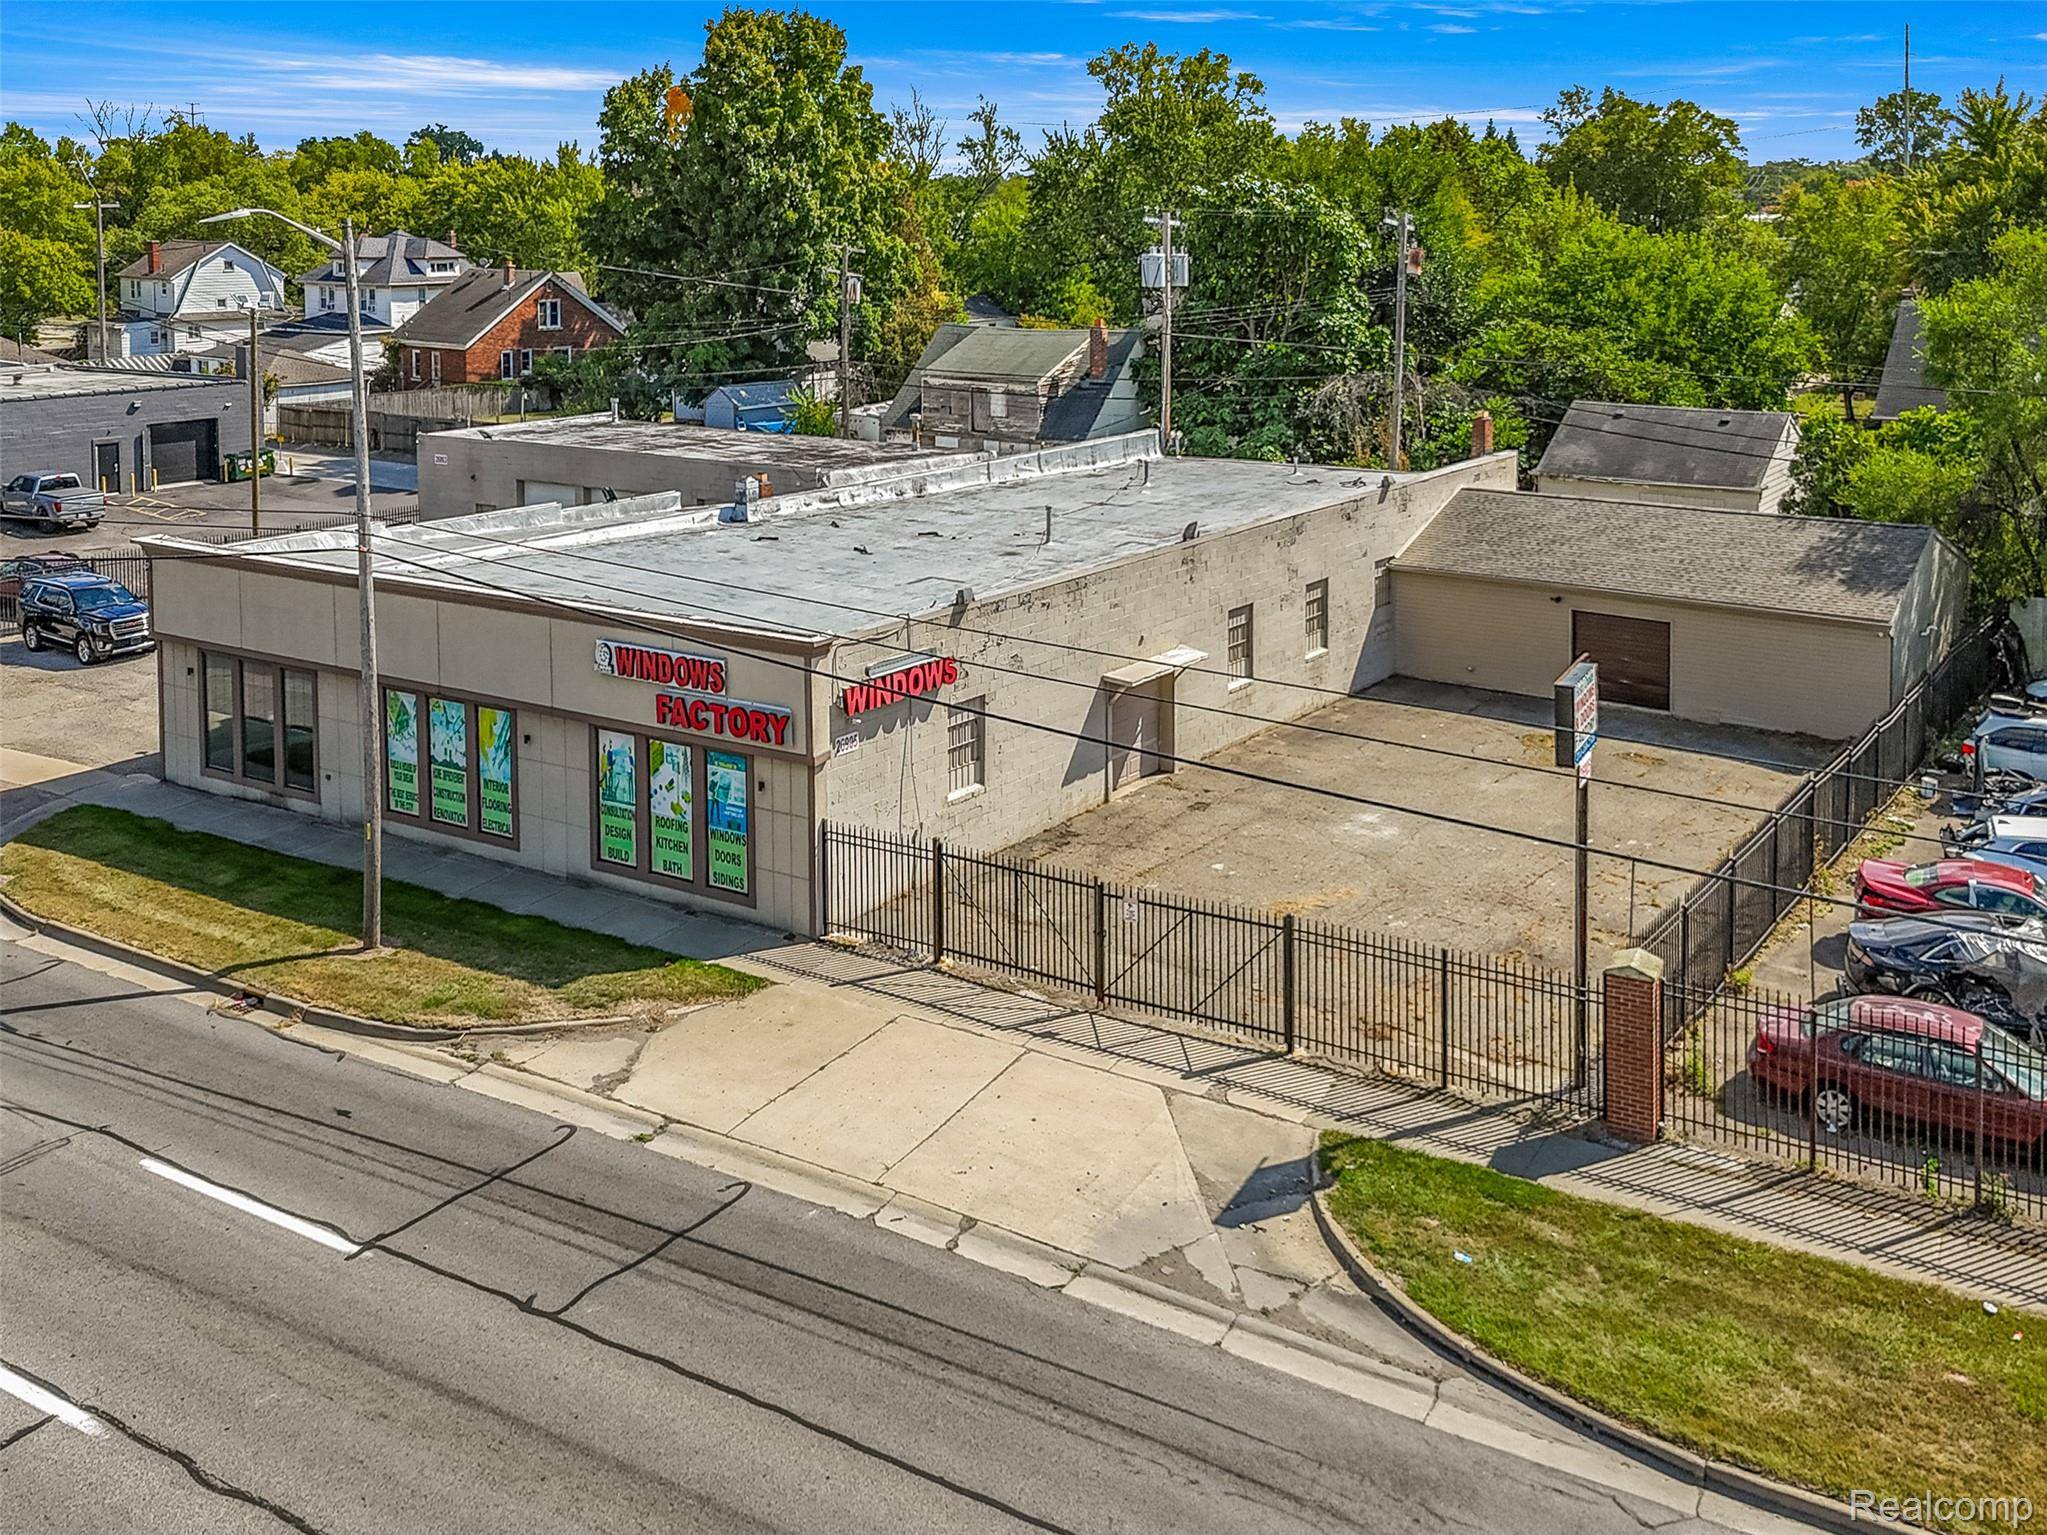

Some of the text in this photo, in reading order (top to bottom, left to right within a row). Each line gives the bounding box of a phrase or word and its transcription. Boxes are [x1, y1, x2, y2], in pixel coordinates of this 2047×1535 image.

[615, 646, 725, 693] WINDOWS
[843, 657, 957, 718] WINDOWS
[656, 694, 790, 745] FACTORY
[483, 778, 509, 794] INTERIOR
[482, 796, 511, 814] FLOORING
[483, 818, 511, 835] ELECTRICAL
[605, 824, 632, 841] DESIGN
[655, 816, 688, 834] ROOFING
[656, 835, 688, 855] KITCHEN
[710, 828, 747, 847] WINDOWS
[608, 847, 630, 862] BUILD
[715, 849, 741, 867] DOORS
[663, 859, 682, 875] BATH
[713, 871, 744, 890] SIDINGS
